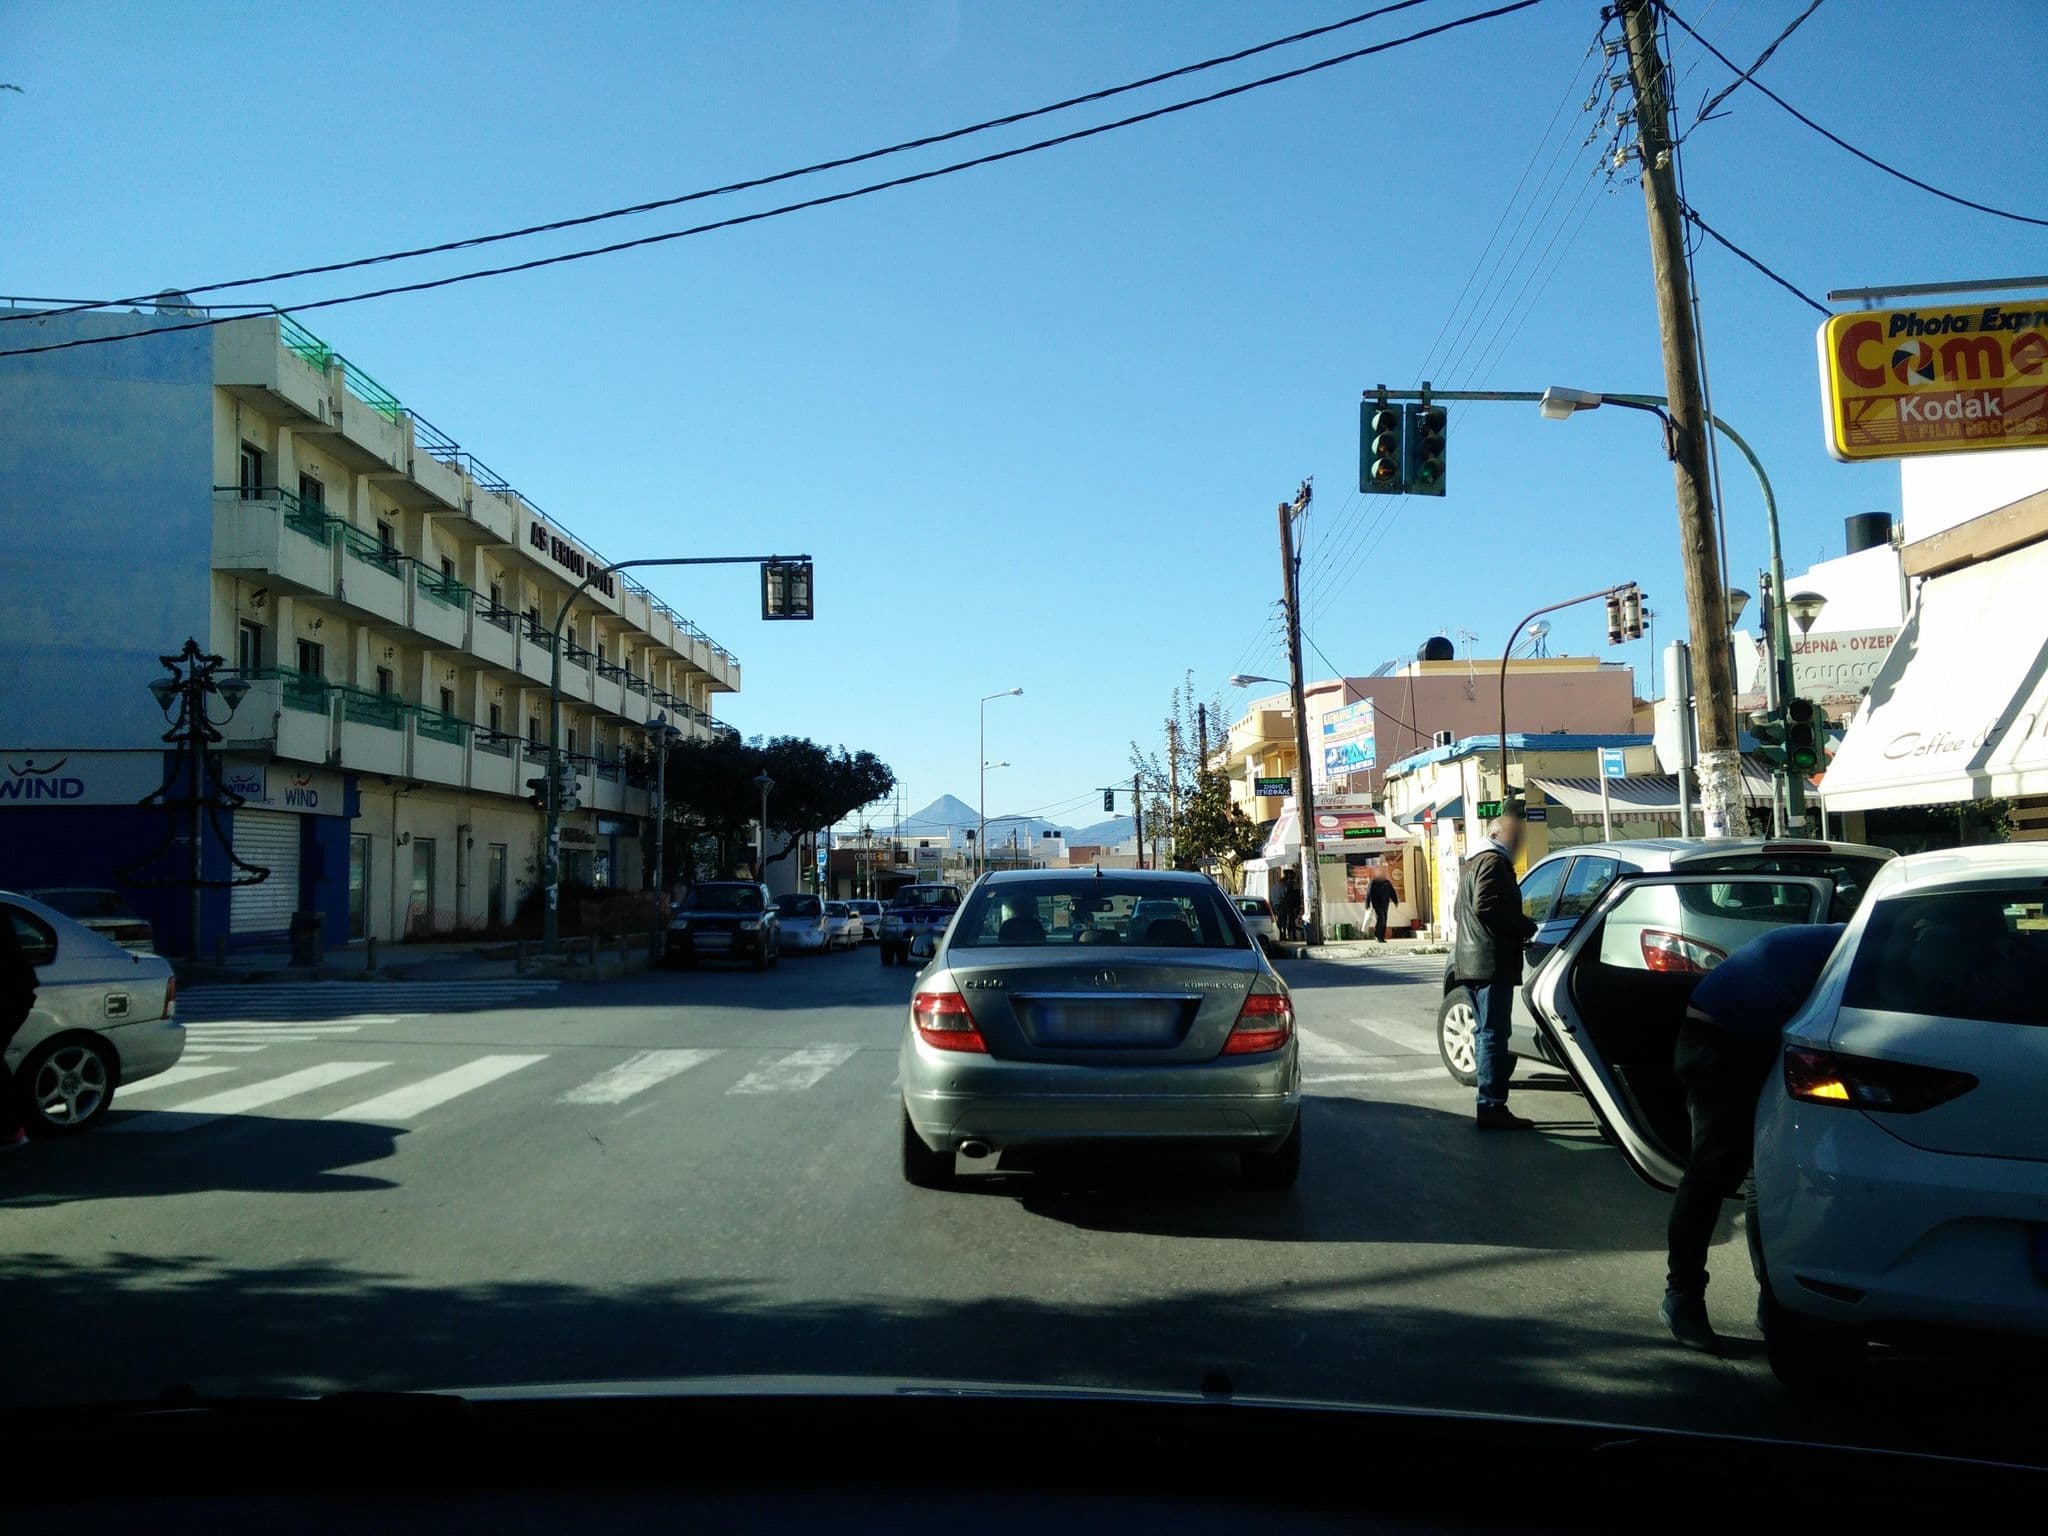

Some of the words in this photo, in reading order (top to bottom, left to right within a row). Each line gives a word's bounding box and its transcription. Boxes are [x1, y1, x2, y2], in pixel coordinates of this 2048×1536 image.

[1887, 312, 1970, 338] Photo
[1899, 392, 2003, 422] Kodak
[1849, 634, 1899, 652] ΟΥΖΕΡ
[1883, 731, 1965, 760] Coffee
[0, 778, 84, 799] WIND
[225, 783, 261, 793] WIND
[284, 787, 319, 808] WIND
